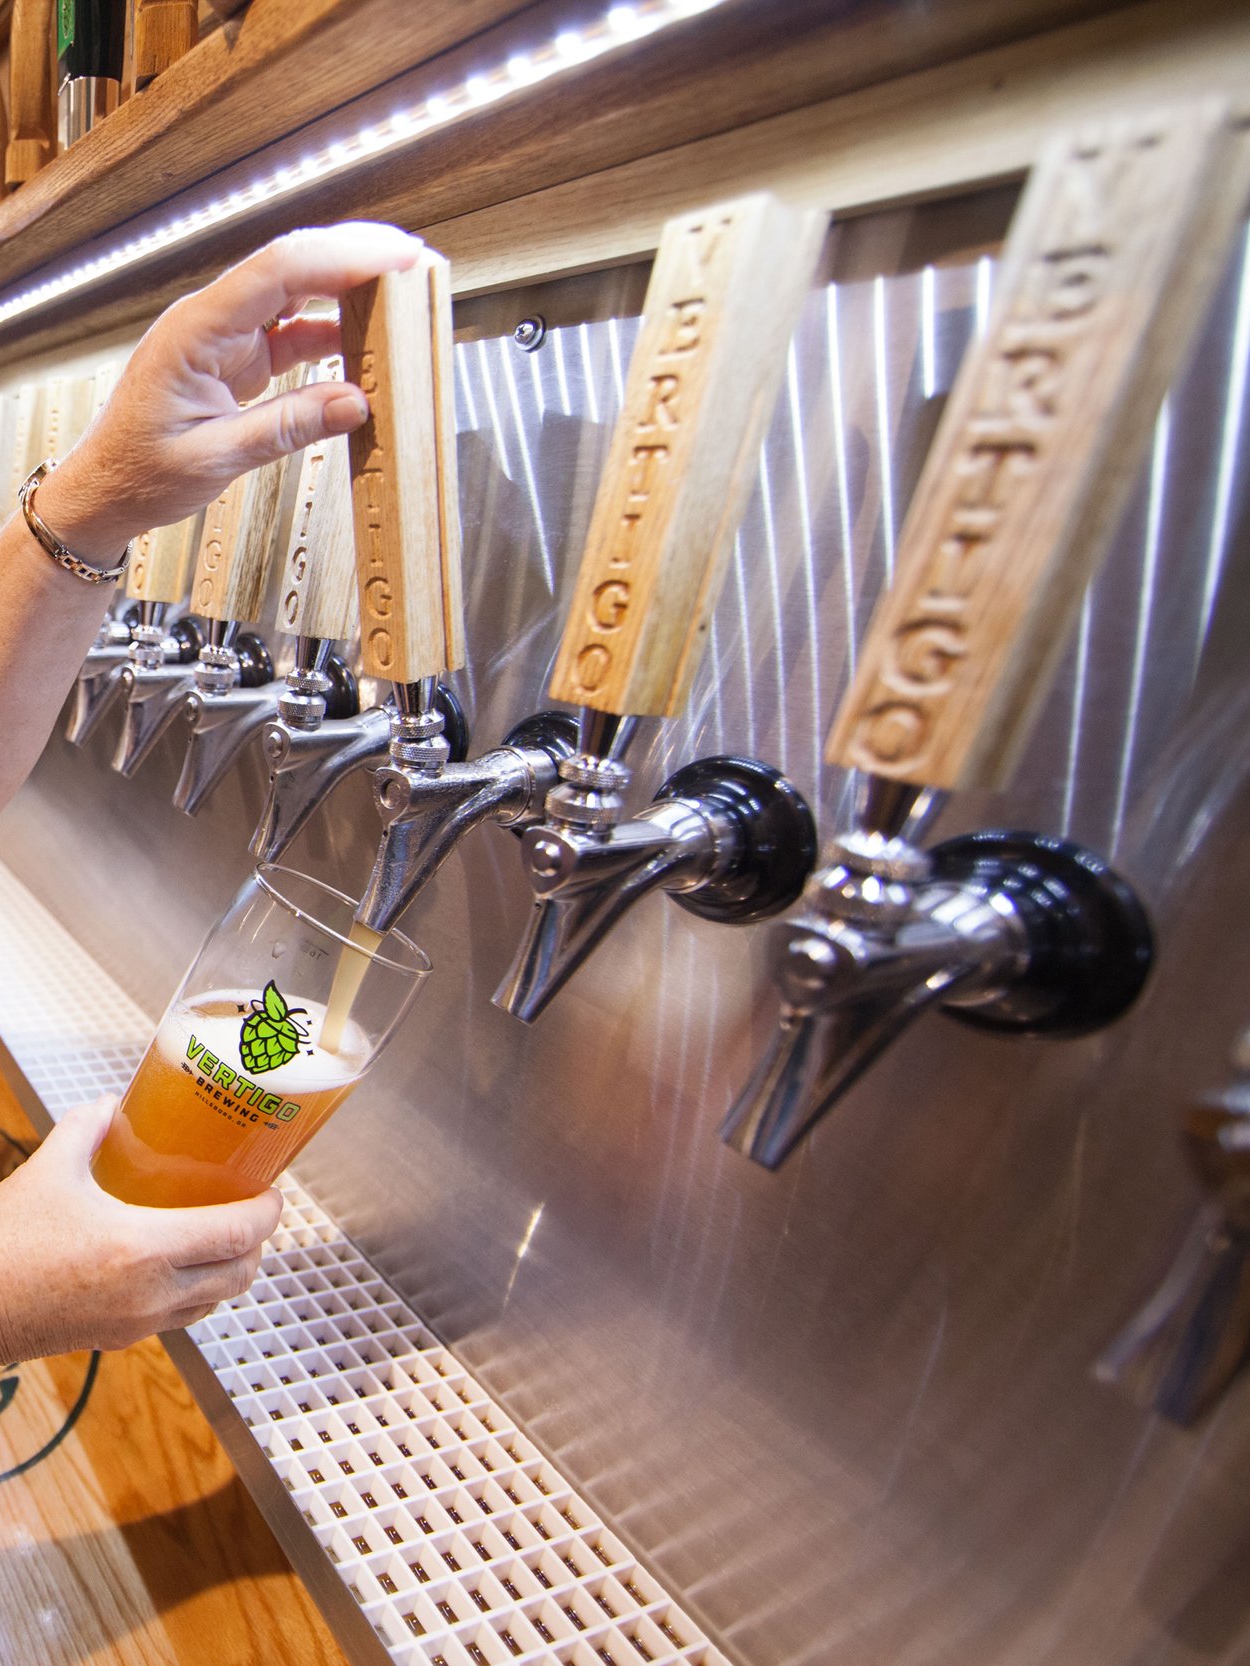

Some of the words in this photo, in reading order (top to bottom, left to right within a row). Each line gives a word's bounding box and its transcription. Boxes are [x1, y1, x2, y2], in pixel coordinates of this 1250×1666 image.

[571, 215, 734, 696] VERTIGO
[848, 138, 1162, 776] VERTIGO
[186, 1034, 302, 1122] VERTIGO
[196, 1076, 260, 1123] BREWING
